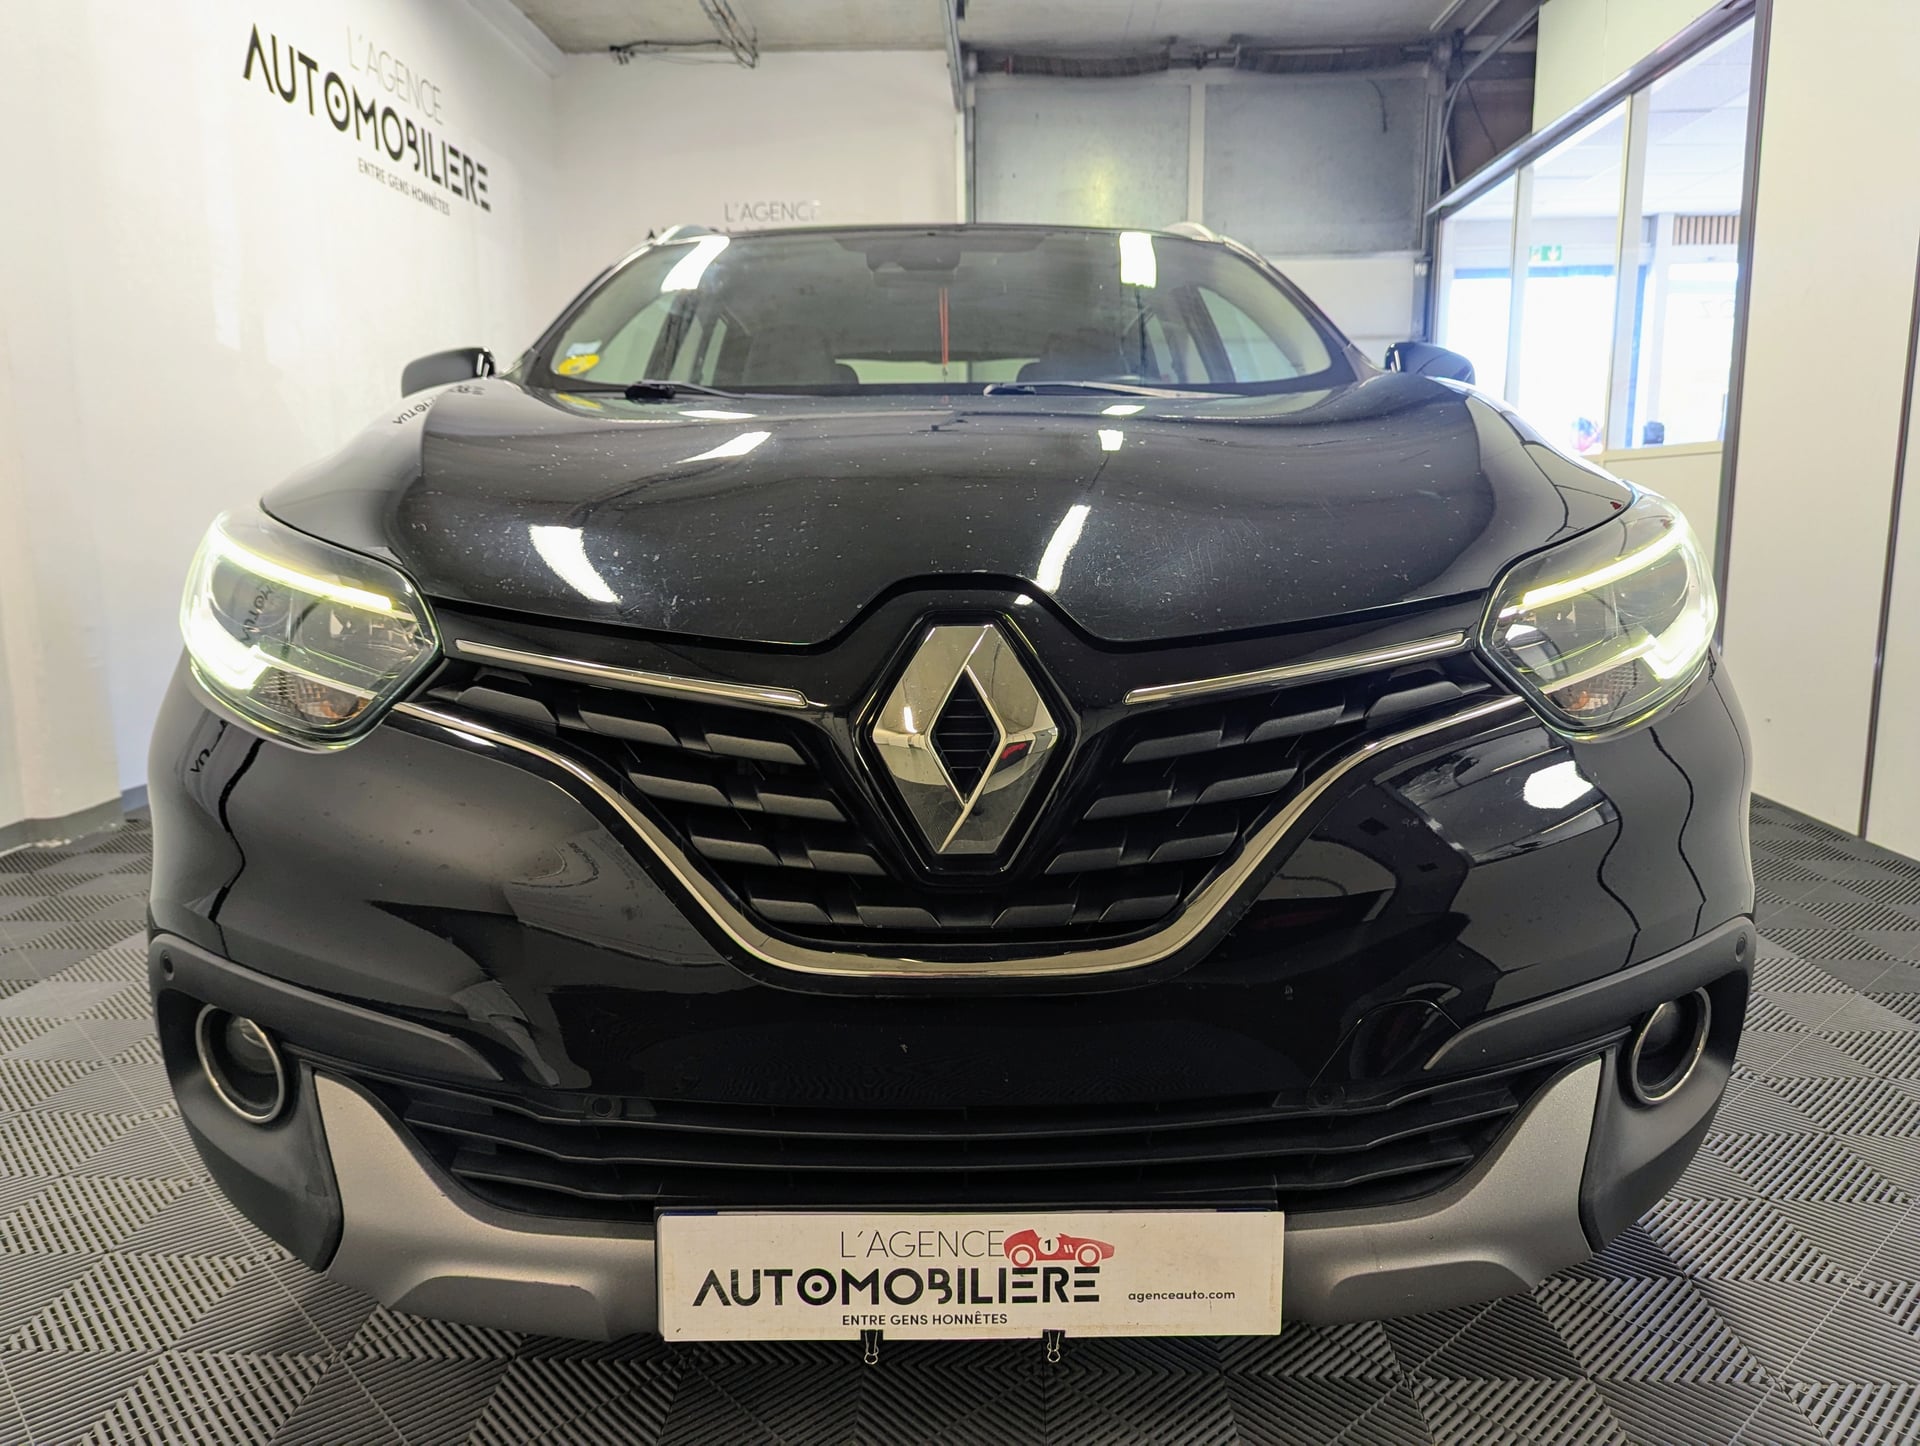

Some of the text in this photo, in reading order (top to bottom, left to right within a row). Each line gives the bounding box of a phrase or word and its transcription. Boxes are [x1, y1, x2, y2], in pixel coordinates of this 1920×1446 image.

[346, 24, 443, 126] L'AGENCE
[357, 157, 386, 185] ENTRE
[387, 173, 410, 196] GENS
[840, 1230, 1005, 1259] L'AGENCE
[1044, 1239, 1053, 1252] 1
[692, 1265, 1101, 1307] AUTOMOBILIERE
[1127, 1289, 1236, 1302] agenceauto.com
[842, 1310, 1008, 1326] ENTRE GENS HONNÊTES
